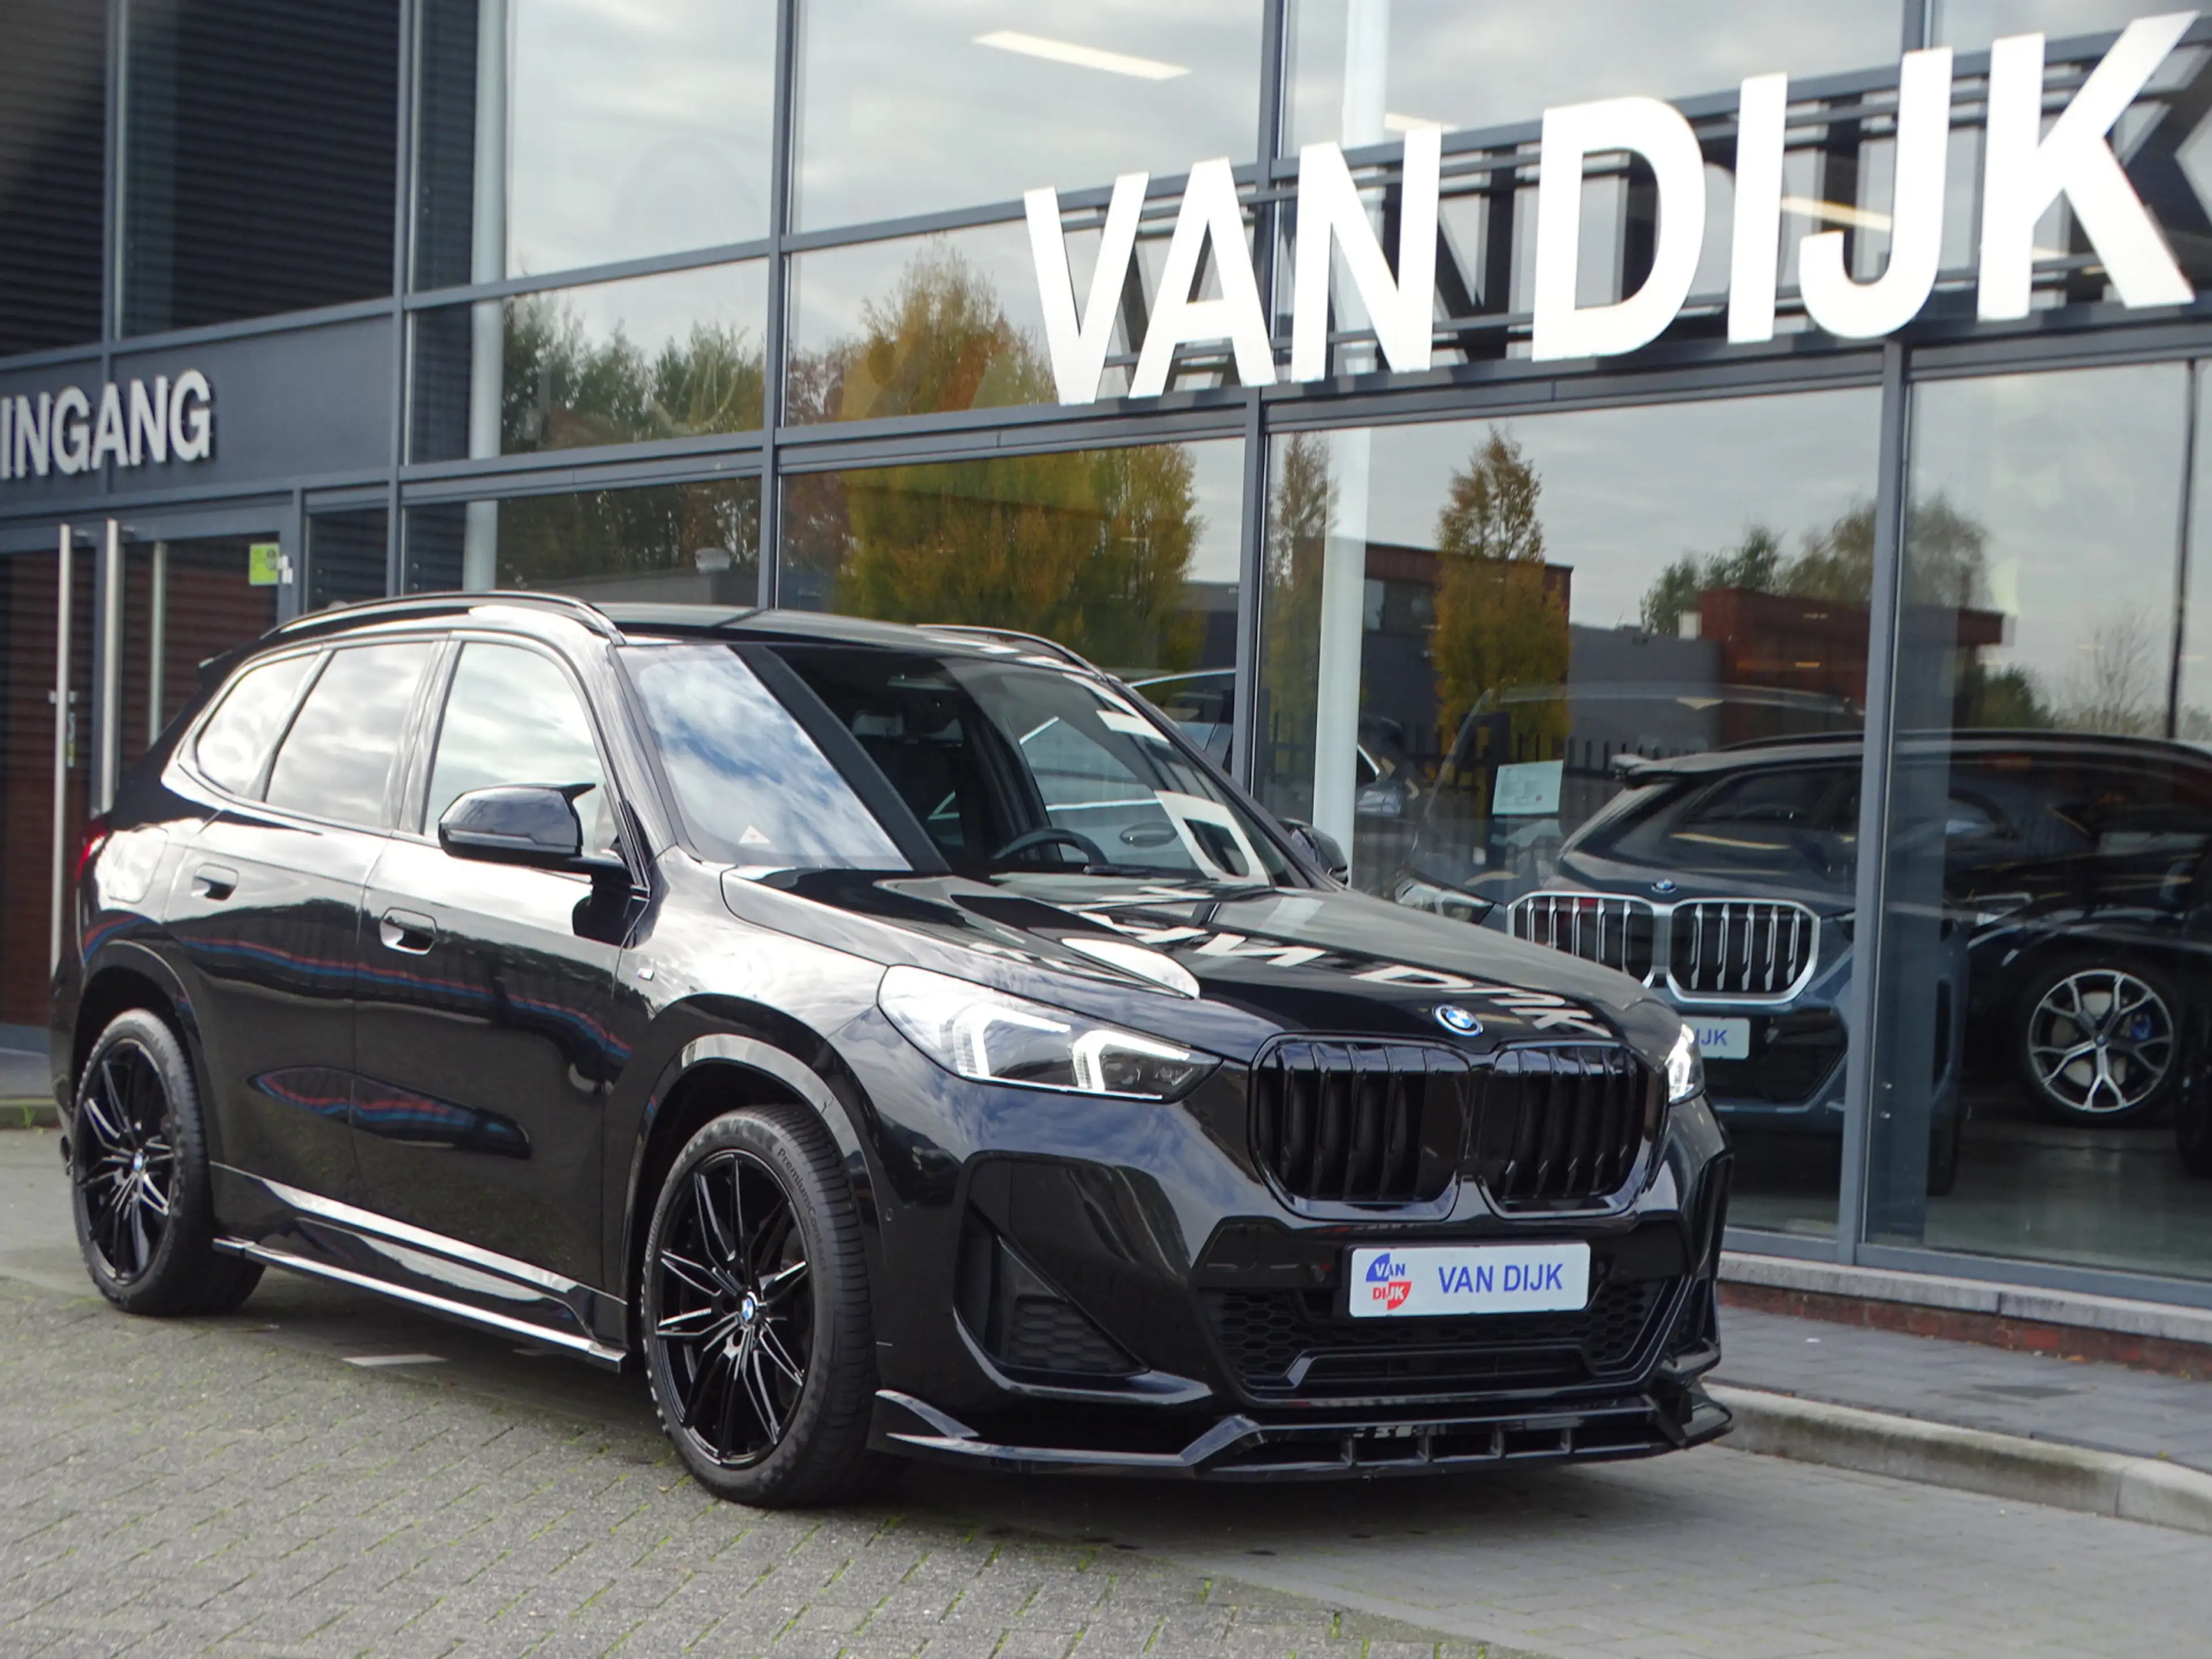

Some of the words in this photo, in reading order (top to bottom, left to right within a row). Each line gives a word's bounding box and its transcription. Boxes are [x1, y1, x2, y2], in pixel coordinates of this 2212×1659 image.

[1023, 124, 1442, 406] VAN
[1531, 10, 2198, 364] DIJK
[0, 367, 211, 480] INGANG
[1694, 1028, 1728, 1047] IJK
[1375, 1262, 1406, 1278] VAN
[1438, 1265, 1494, 1294] VAN
[1503, 1263, 1564, 1292] DIJK
[1372, 1286, 1405, 1300] DIJK
